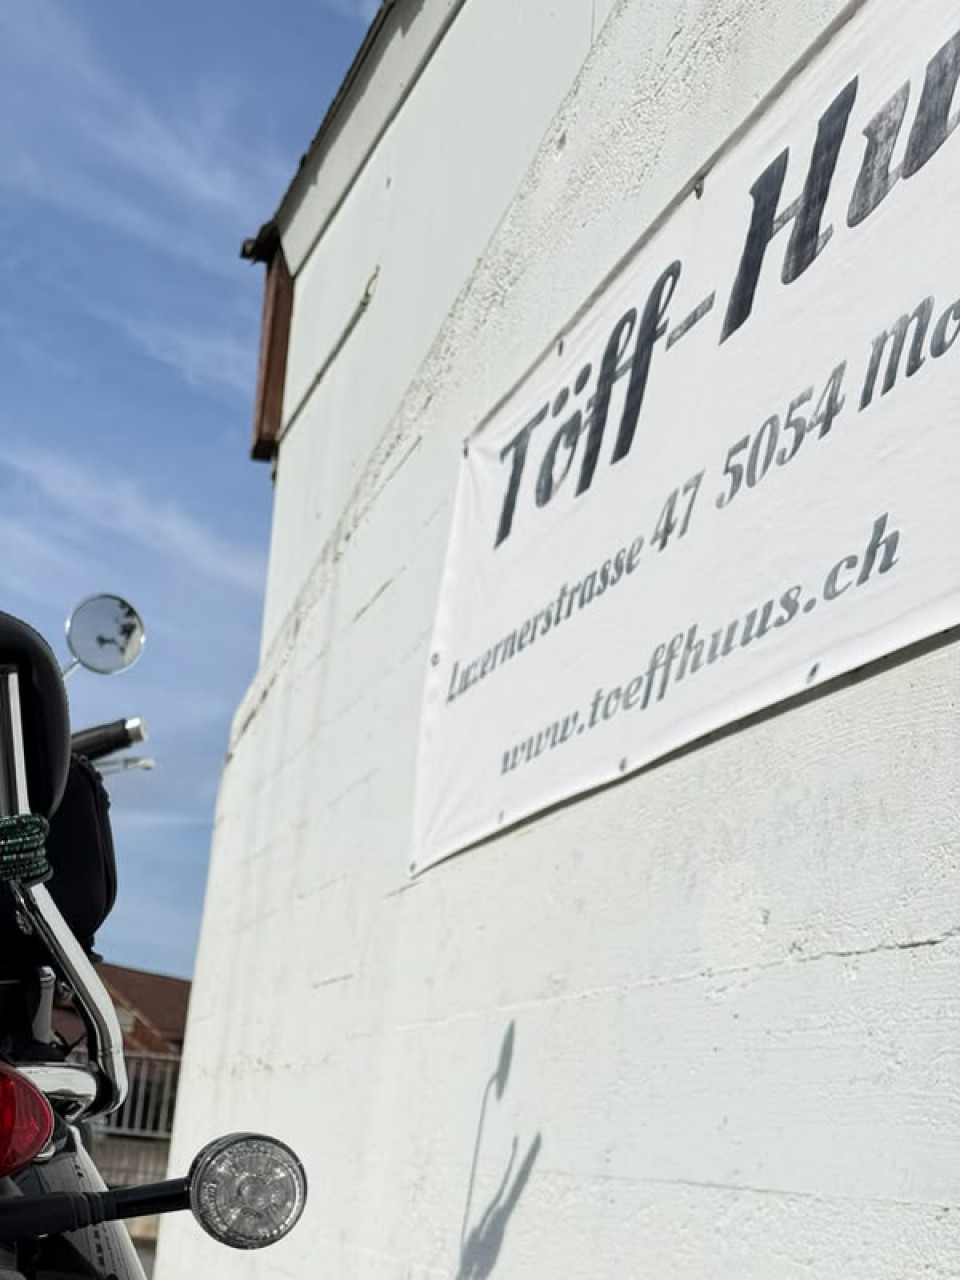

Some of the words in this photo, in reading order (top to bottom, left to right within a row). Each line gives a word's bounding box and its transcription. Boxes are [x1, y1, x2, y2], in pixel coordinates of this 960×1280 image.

[446, 536, 644, 704] Luzernerstrasse
[650, 468, 705, 552] 47
[715, 360, 847, 509] 5054
[500, 512, 900, 775] www.toeffhuus.ch
